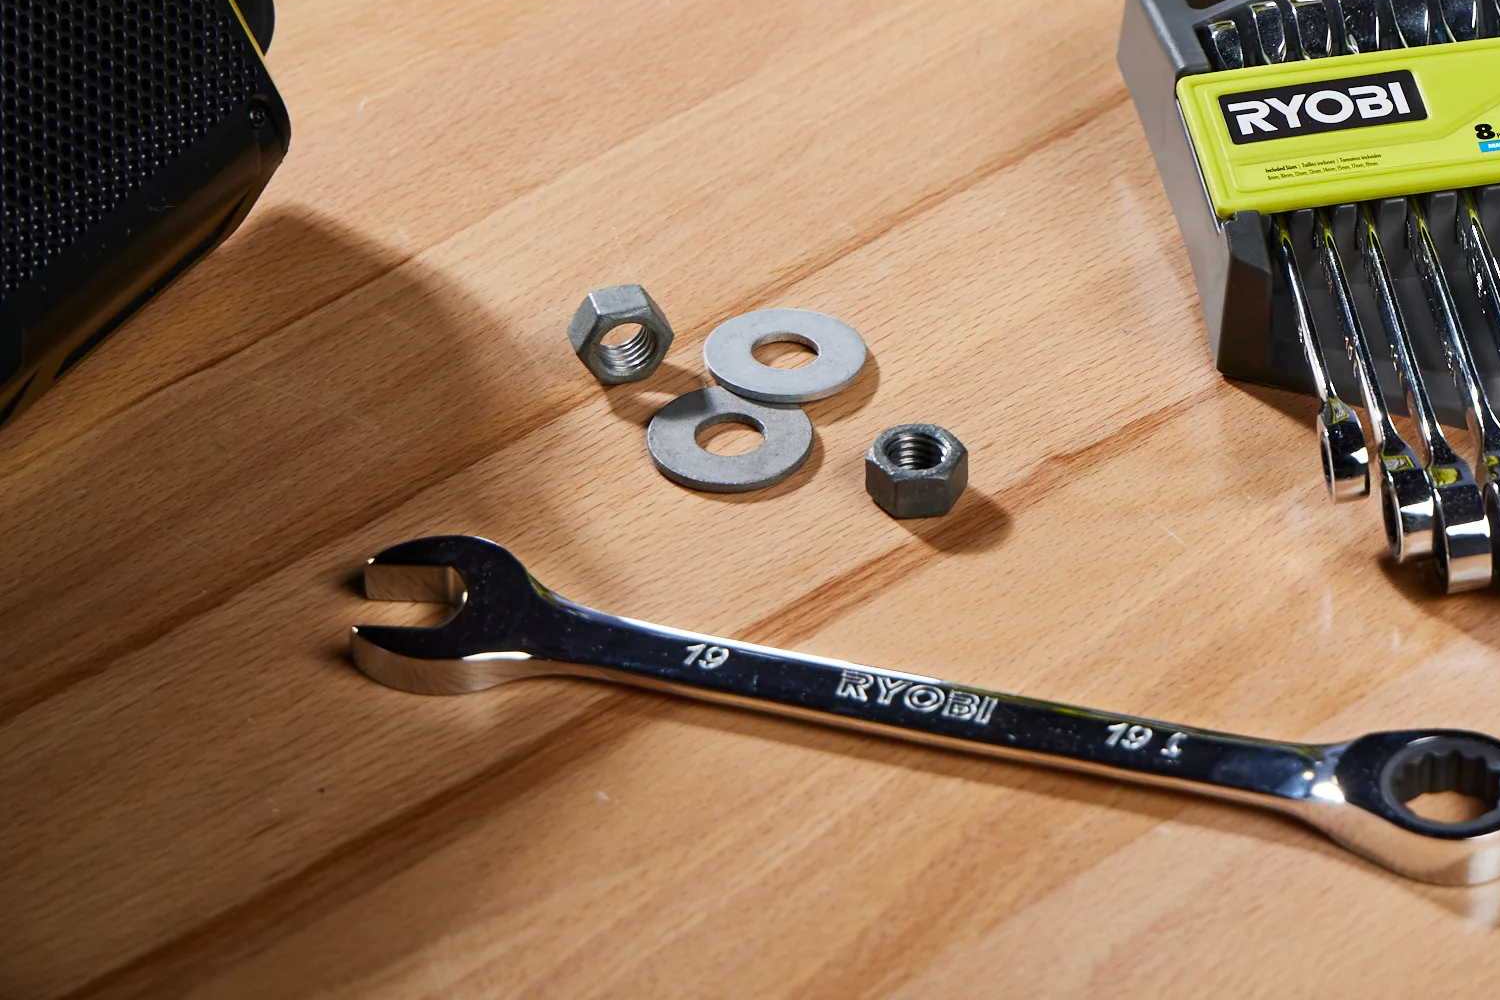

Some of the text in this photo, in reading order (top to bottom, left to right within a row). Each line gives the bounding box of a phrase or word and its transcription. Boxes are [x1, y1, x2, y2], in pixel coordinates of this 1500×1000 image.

[1227, 81, 1411, 136] RYOBI
[1474, 123, 1496, 140] 8
[1265, 165, 1285, 173] Included
[684, 643, 1154, 751] 19 RYOBI 19
